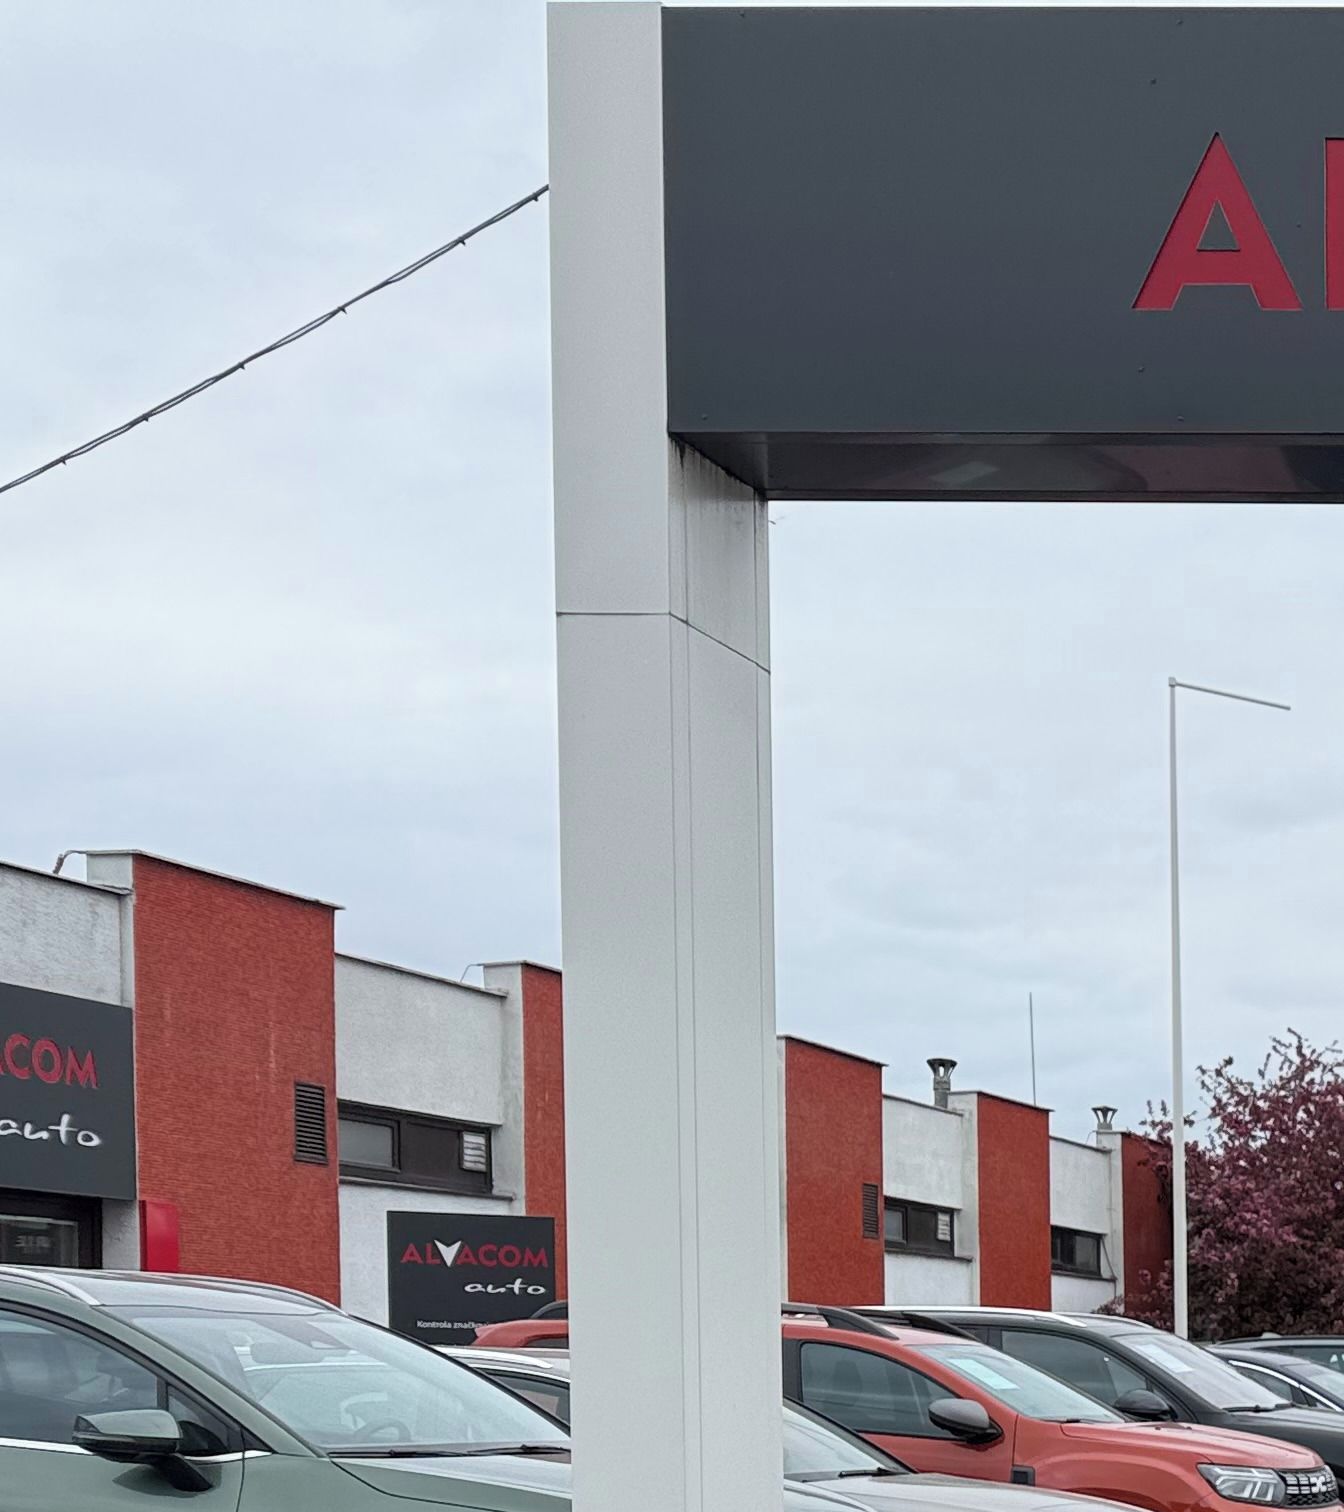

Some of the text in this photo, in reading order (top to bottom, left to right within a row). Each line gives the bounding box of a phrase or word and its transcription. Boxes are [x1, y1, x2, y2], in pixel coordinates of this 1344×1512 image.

[0, 1033, 98, 1089] COM
[0, 1113, 103, 1147] auto
[400, 1239, 549, 1268] ALVACOM
[464, 1278, 547, 1295] auto
